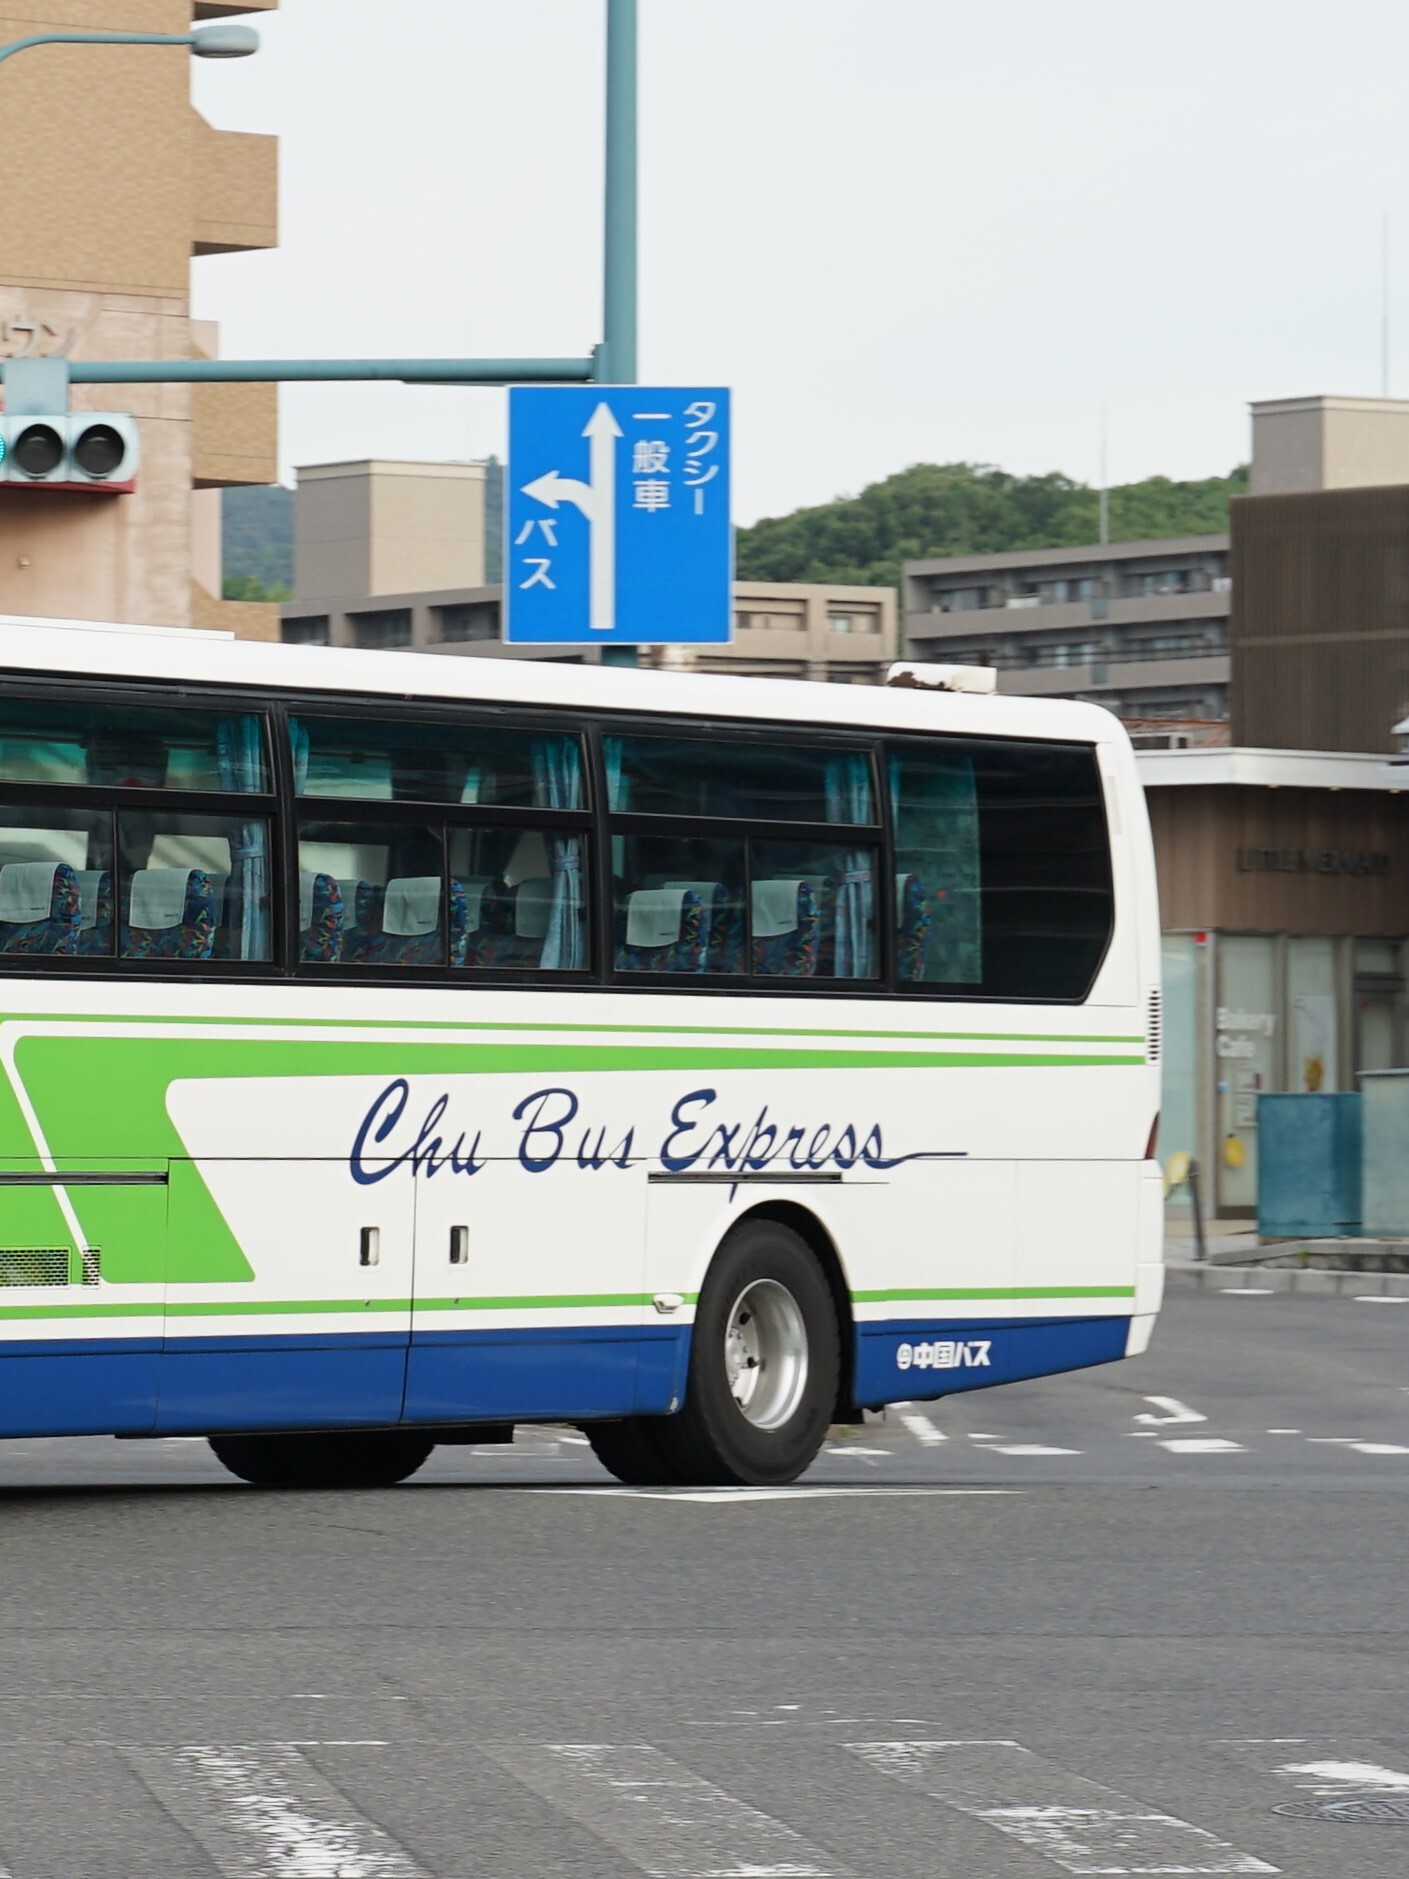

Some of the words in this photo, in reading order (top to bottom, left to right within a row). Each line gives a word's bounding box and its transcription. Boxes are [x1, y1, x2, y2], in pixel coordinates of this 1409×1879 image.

[632, 412, 672, 513] 一般車
[683, 401, 720, 515] タクシー
[514, 518, 559, 590] バス
[350, 1078, 486, 1186] Chu
[512, 1088, 638, 1173] Bus
[660, 1088, 969, 1203] Express
